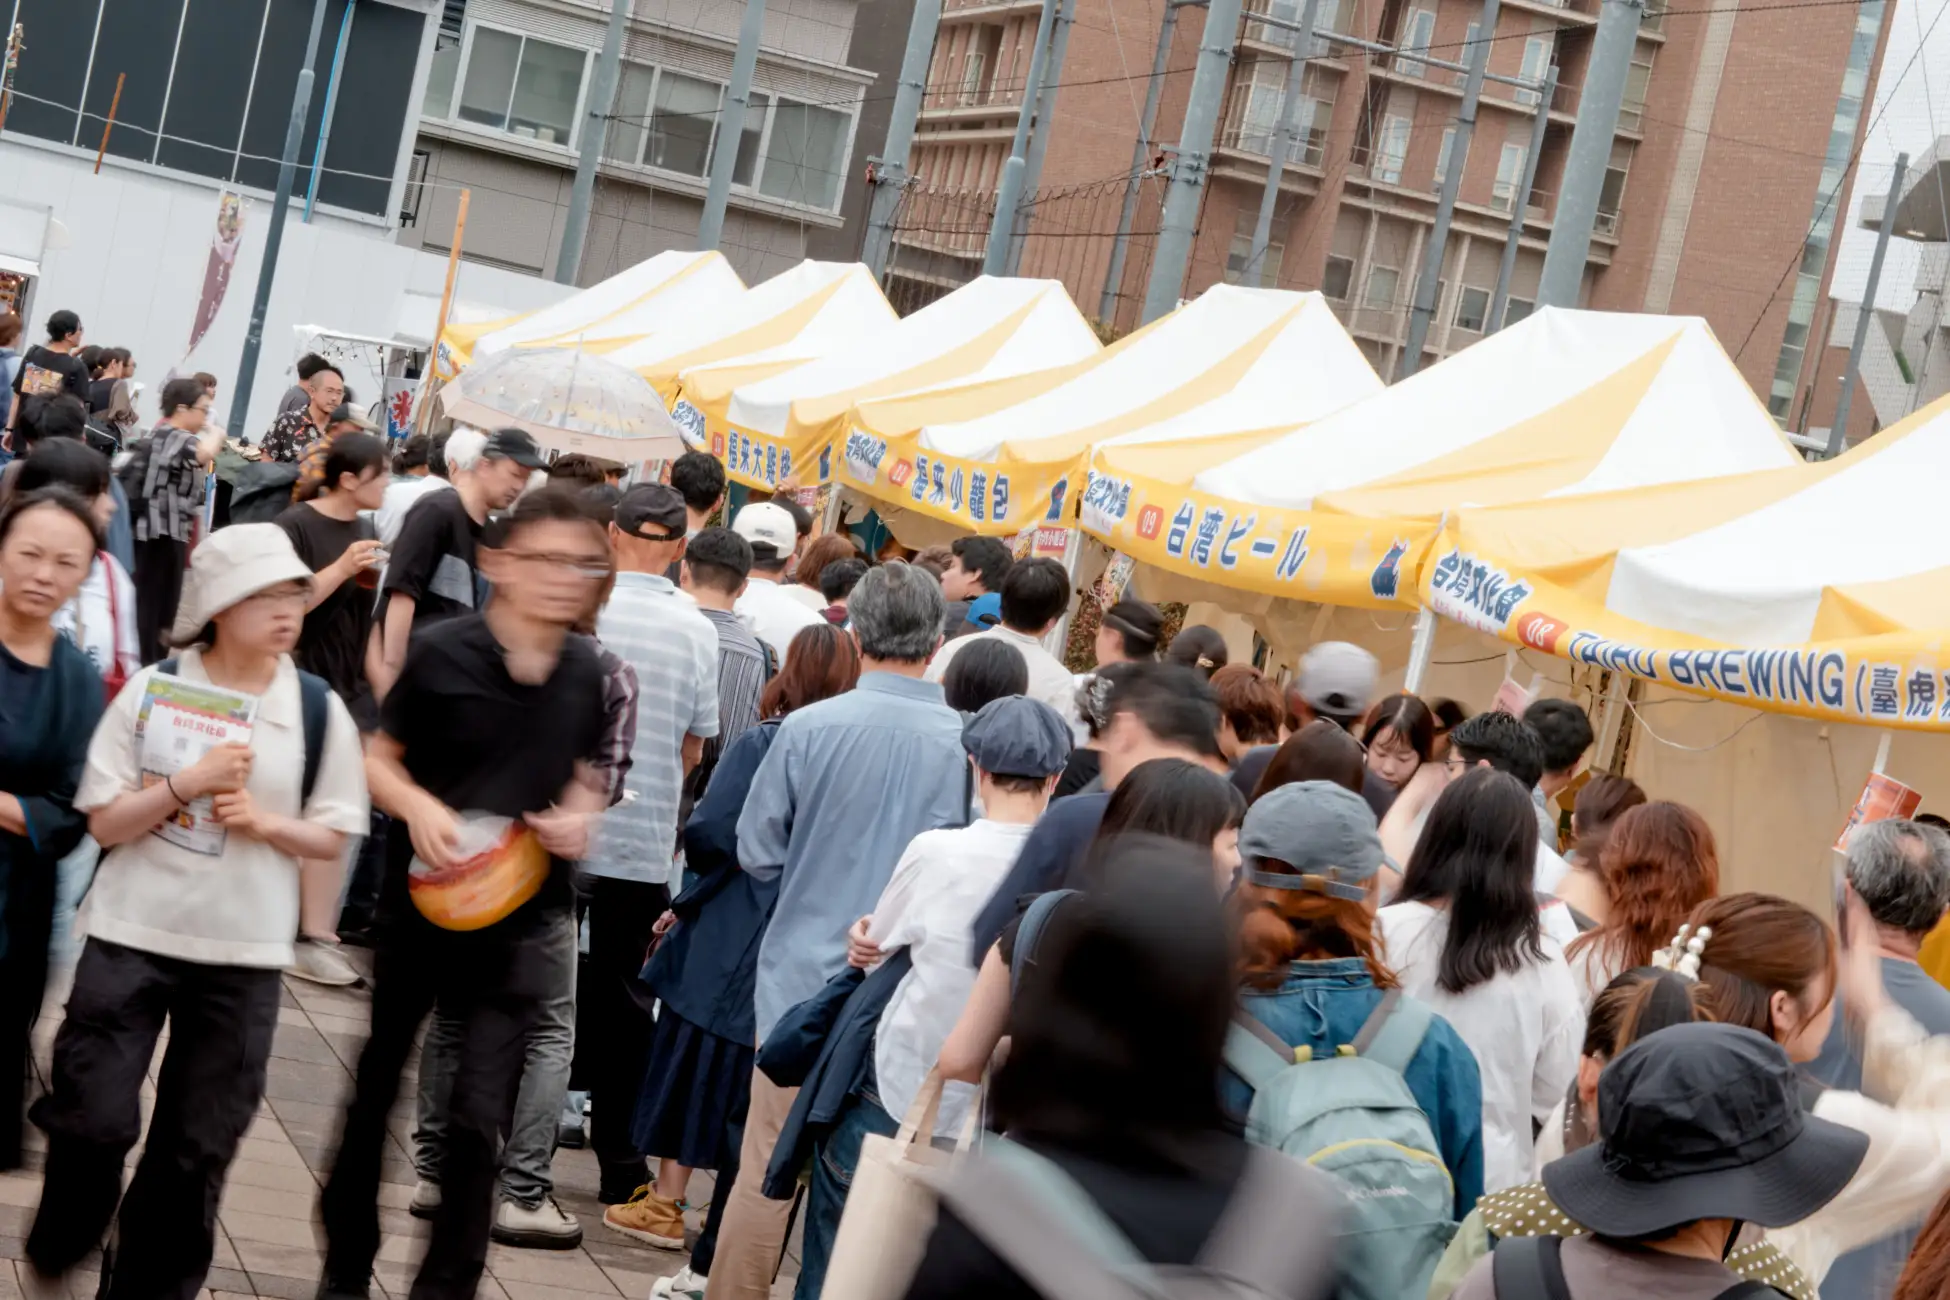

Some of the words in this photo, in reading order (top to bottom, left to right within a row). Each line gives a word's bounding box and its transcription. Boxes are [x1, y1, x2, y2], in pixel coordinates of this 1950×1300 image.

[1142, 511, 1158, 535] 09
[1167, 501, 1310, 579] 台湾ビール
[1526, 616, 1555, 649] 08
[1568, 631, 1658, 680] TAIHU
[1668, 650, 1845, 708] BREWING
